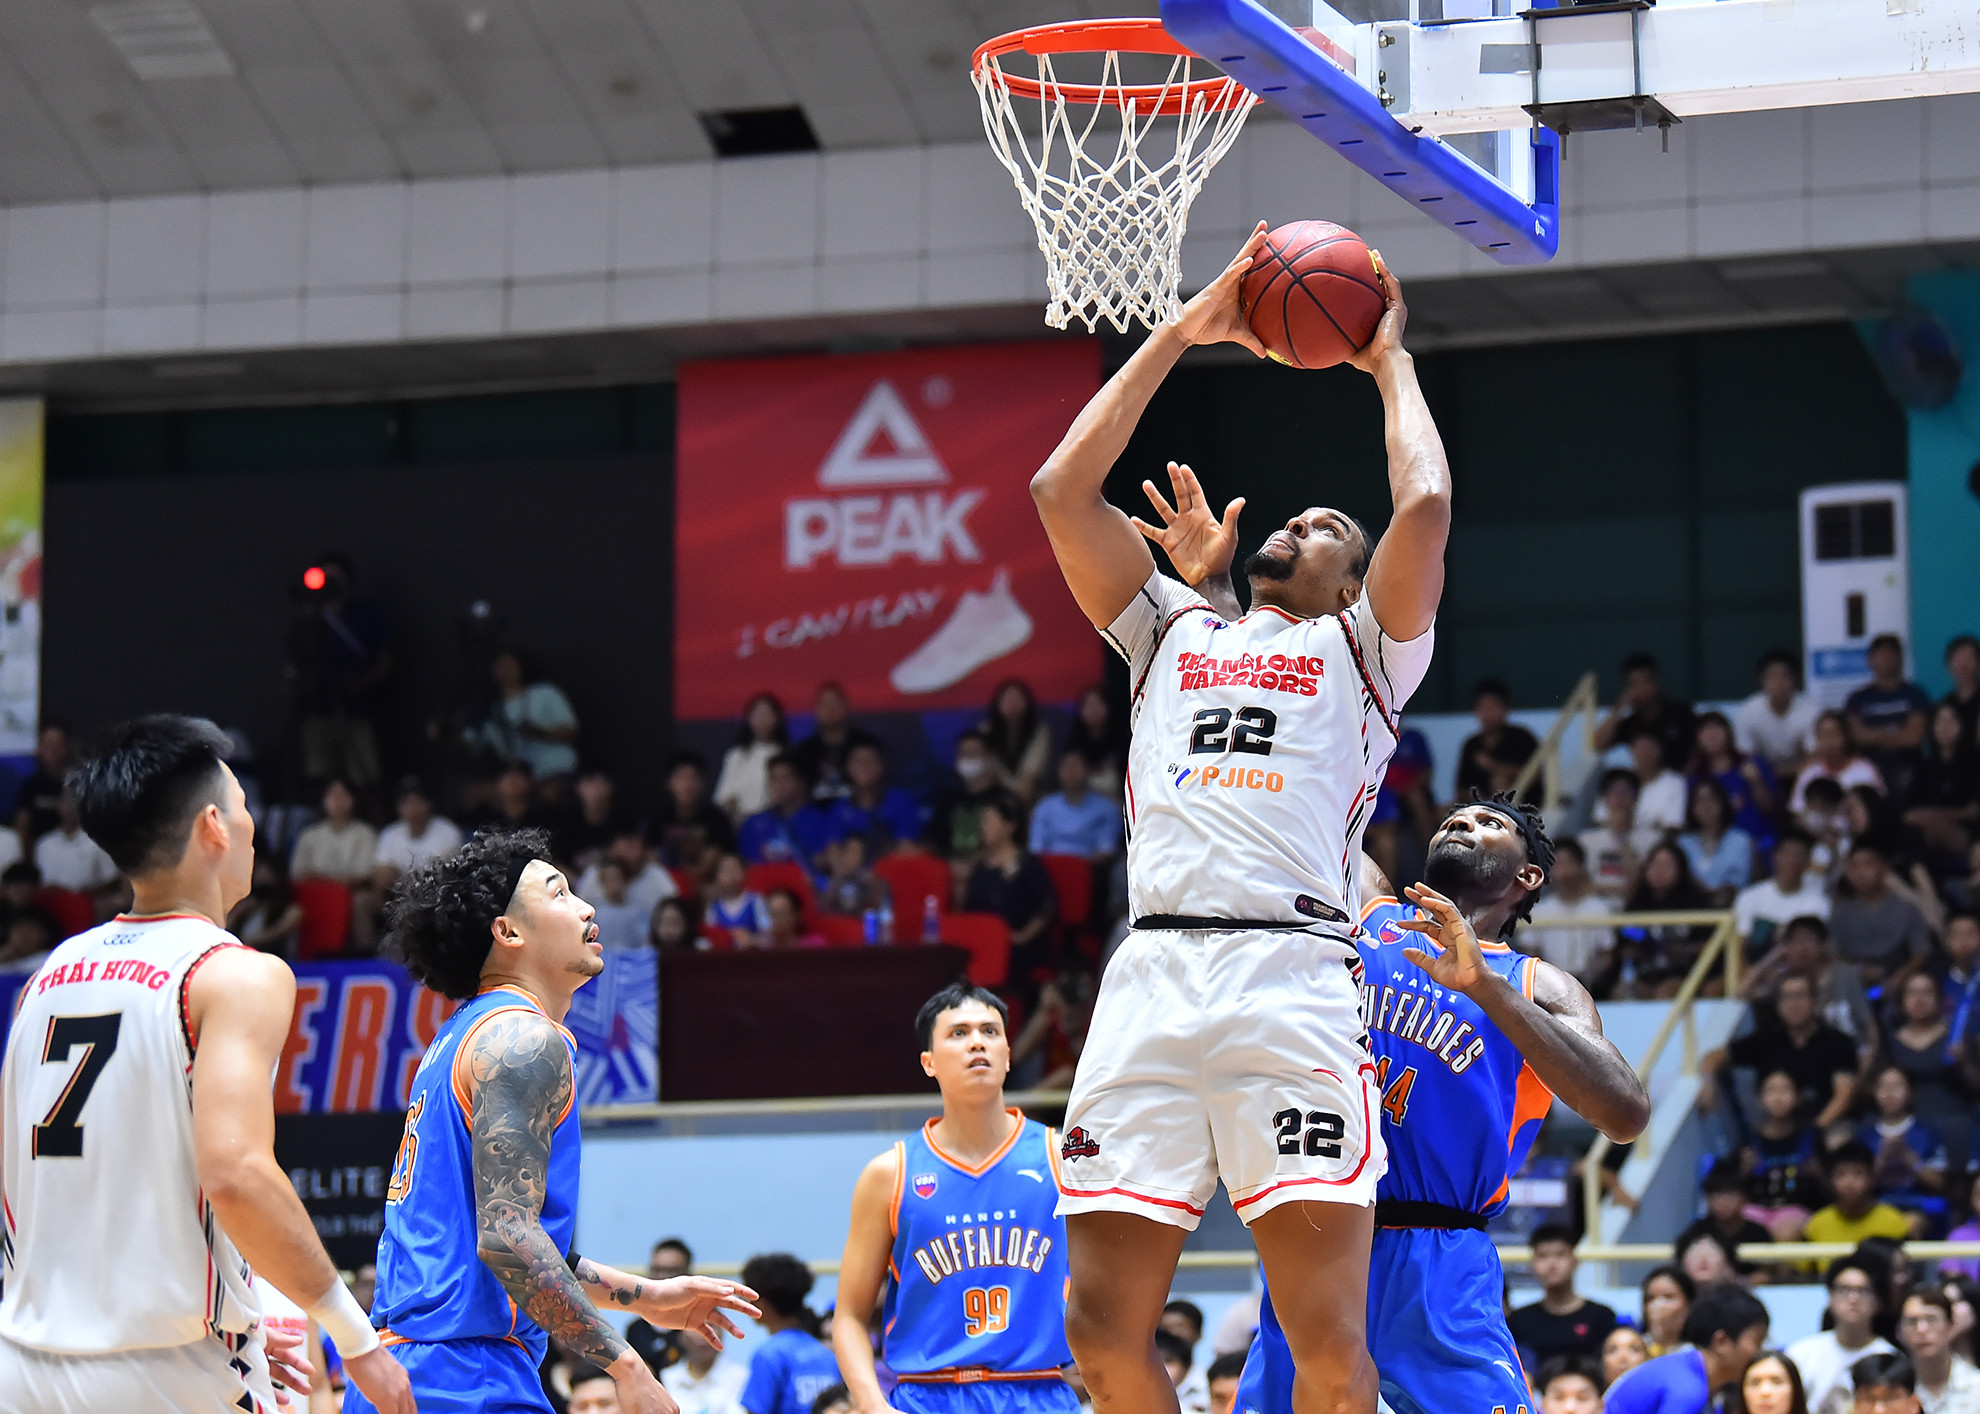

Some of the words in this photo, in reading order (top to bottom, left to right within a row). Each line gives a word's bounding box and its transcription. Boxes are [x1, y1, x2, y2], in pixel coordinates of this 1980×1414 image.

[785, 488, 988, 570] PEAK
[1179, 671, 1318, 697] WARRIORS
[1188, 705, 1278, 756] 22
[1201, 765, 1284, 793] PJICO
[38, 957, 99, 996] THÁI
[1364, 983, 1485, 1075] UFFALOES
[32, 1010, 124, 1160] 7
[1272, 1107, 1345, 1159] 22
[289, 1166, 384, 1200] ELITE
[916, 1175, 935, 1186] VBA
[946, 1209, 1017, 1224] HANOI
[912, 1225, 1053, 1286] BUFFALOES
[963, 1284, 1010, 1338] 99
